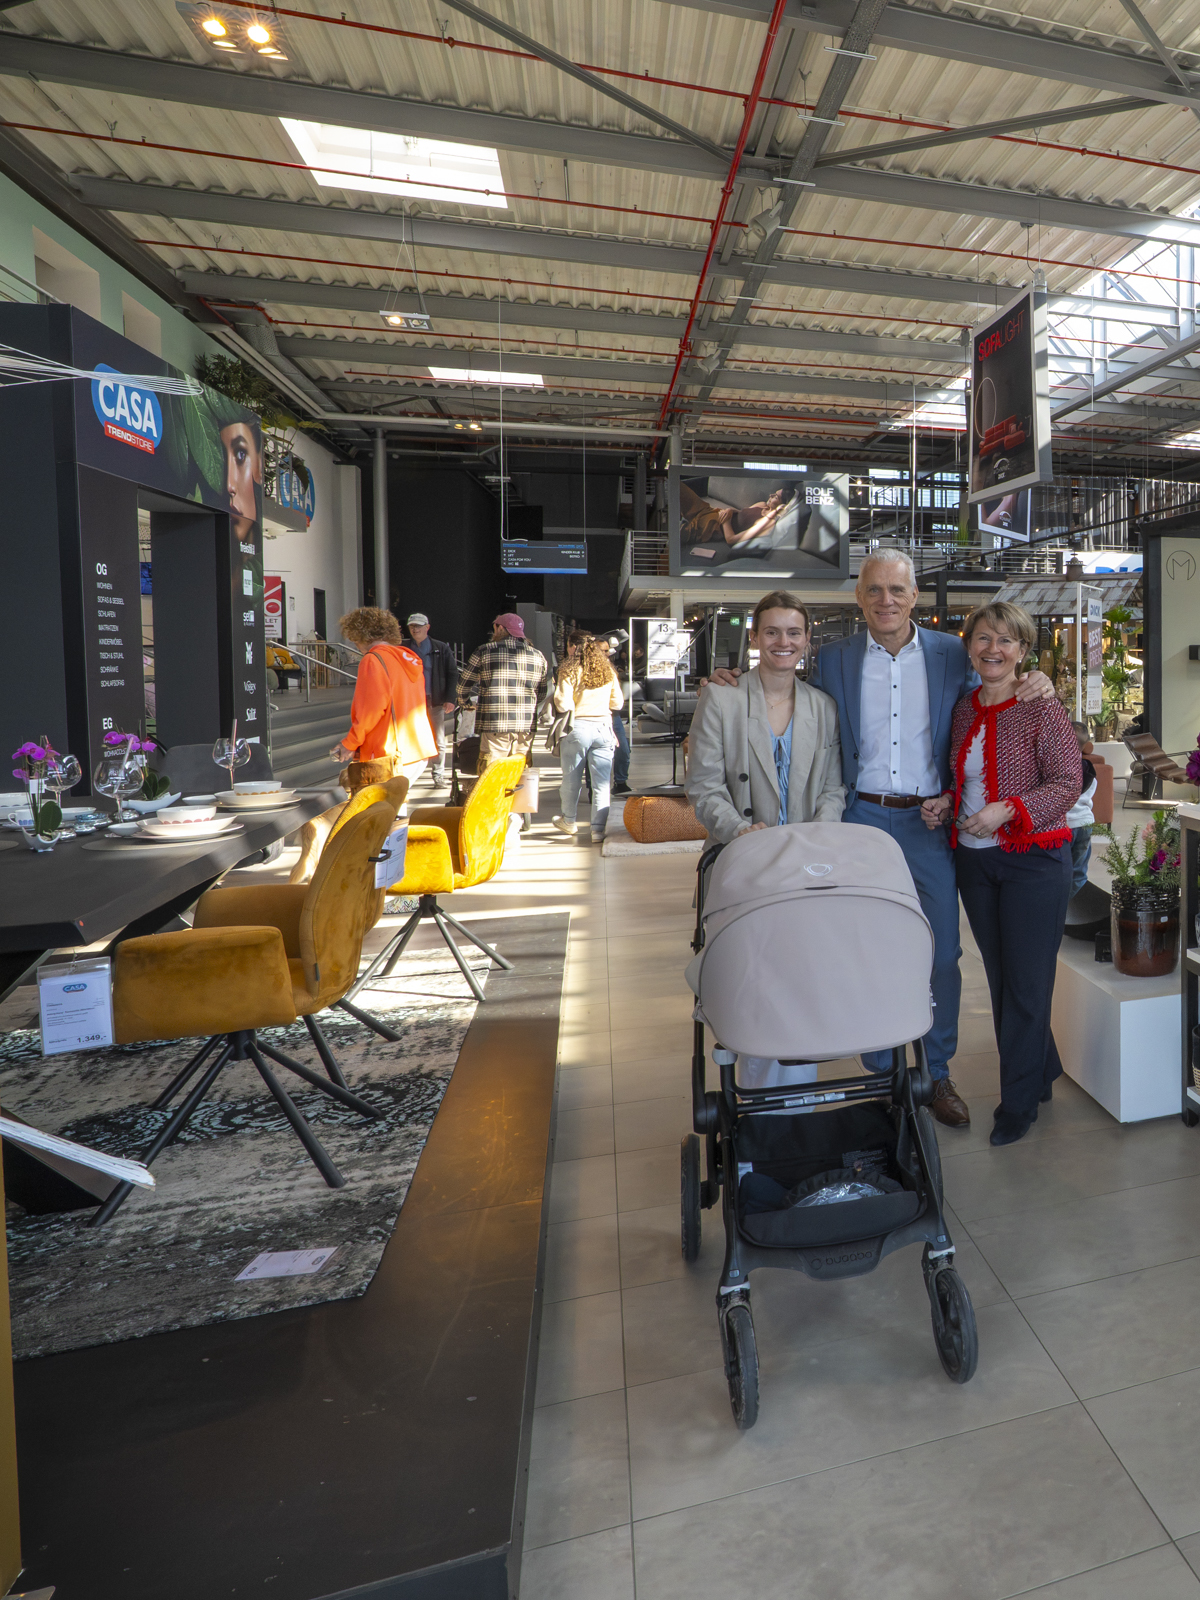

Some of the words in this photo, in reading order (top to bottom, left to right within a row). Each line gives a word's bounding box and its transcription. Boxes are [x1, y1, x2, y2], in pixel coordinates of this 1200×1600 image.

[978, 309, 1025, 362] SOFALIGHT
[99, 380, 158, 438] CASA
[107, 424, 153, 452] TRENDSTORE
[805, 486, 835, 496] ROLF
[805, 496, 835, 506] BENZ
[96, 562, 108, 576] OG
[102, 716, 113, 730] EG
